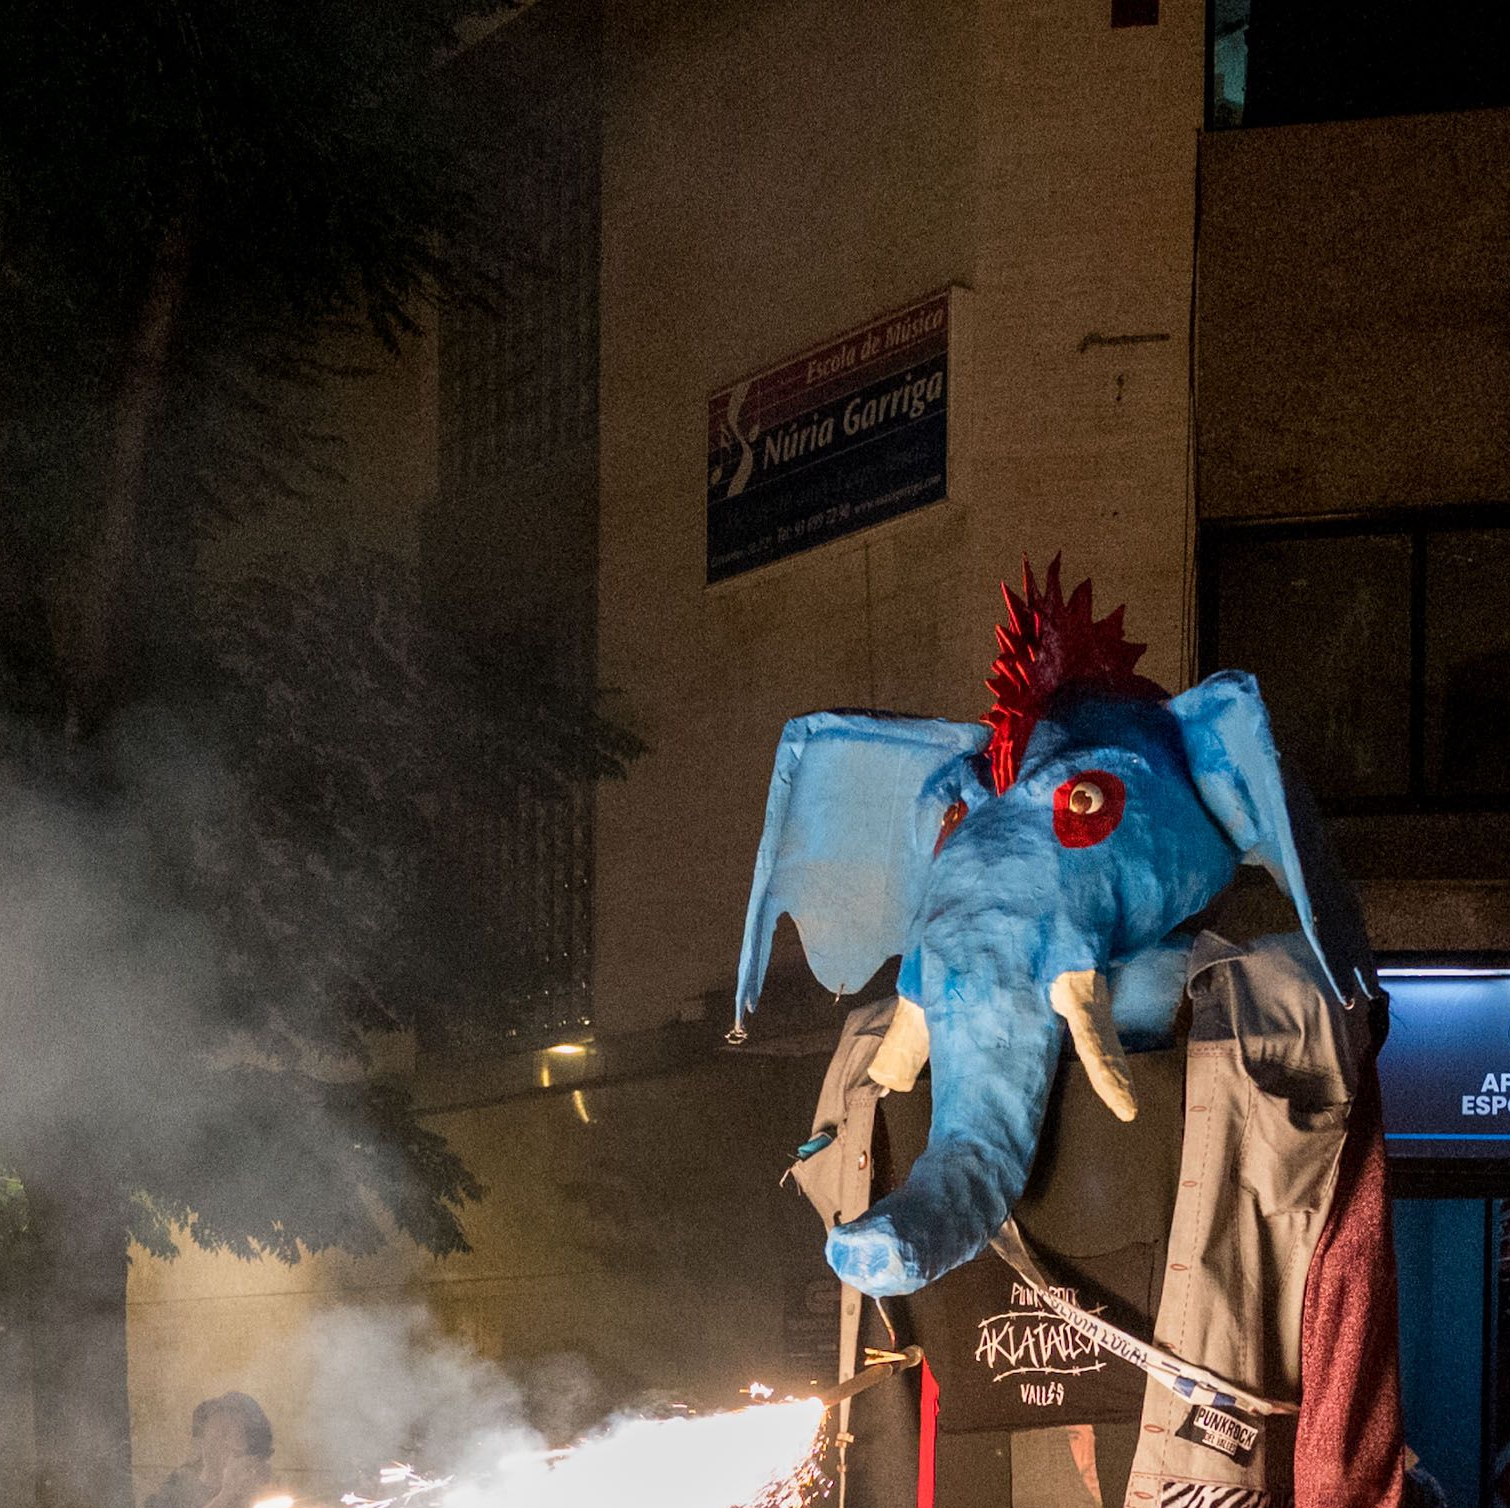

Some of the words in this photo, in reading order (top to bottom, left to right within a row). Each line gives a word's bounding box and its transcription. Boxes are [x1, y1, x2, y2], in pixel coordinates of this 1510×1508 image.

[807, 342, 855, 384] Escola
[860, 335, 880, 358] de
[886, 308, 943, 347] Música
[763, 412, 834, 471] Núria
[843, 371, 943, 437] Garriga
[1196, 1408, 1256, 1448] PUNKROCK
